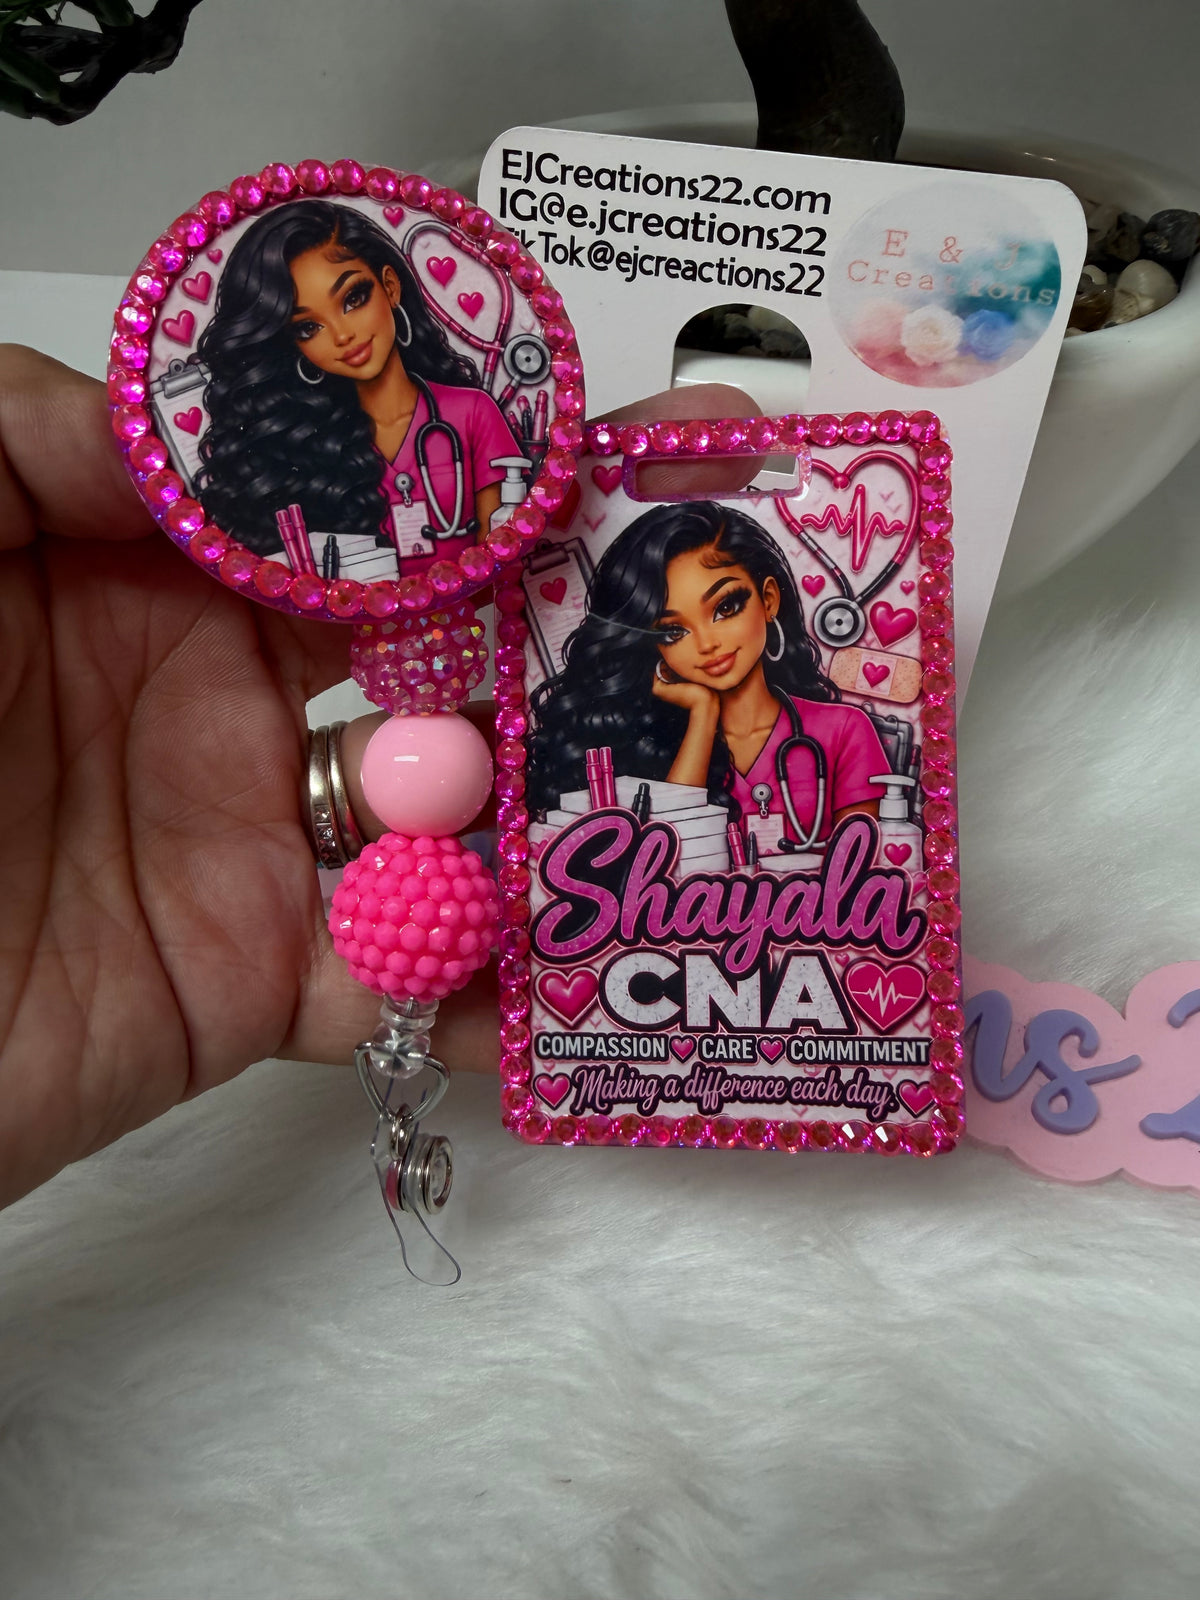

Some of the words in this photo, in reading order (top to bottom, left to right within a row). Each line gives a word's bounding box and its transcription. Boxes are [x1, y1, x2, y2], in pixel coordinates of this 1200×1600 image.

[501, 148, 831, 214] EJCreations22.com
[499, 187, 827, 256] IG@e.jcreations22
[881, 229, 909, 257] E
[939, 236, 963, 264] &
[533, 812, 923, 974] Shayala
[603, 950, 832, 1030] CNA
[537, 1036, 666, 1058] COMPASSION
[701, 1039, 754, 1061] CARE
[790, 1040, 930, 1063] COMMITMENT
[574, 1066, 660, 1112] Making
[664, 1080, 681, 1098] a
[684, 1066, 787, 1110] difference
[791, 1070, 841, 1102] each
[845, 1072, 896, 1118] day.
